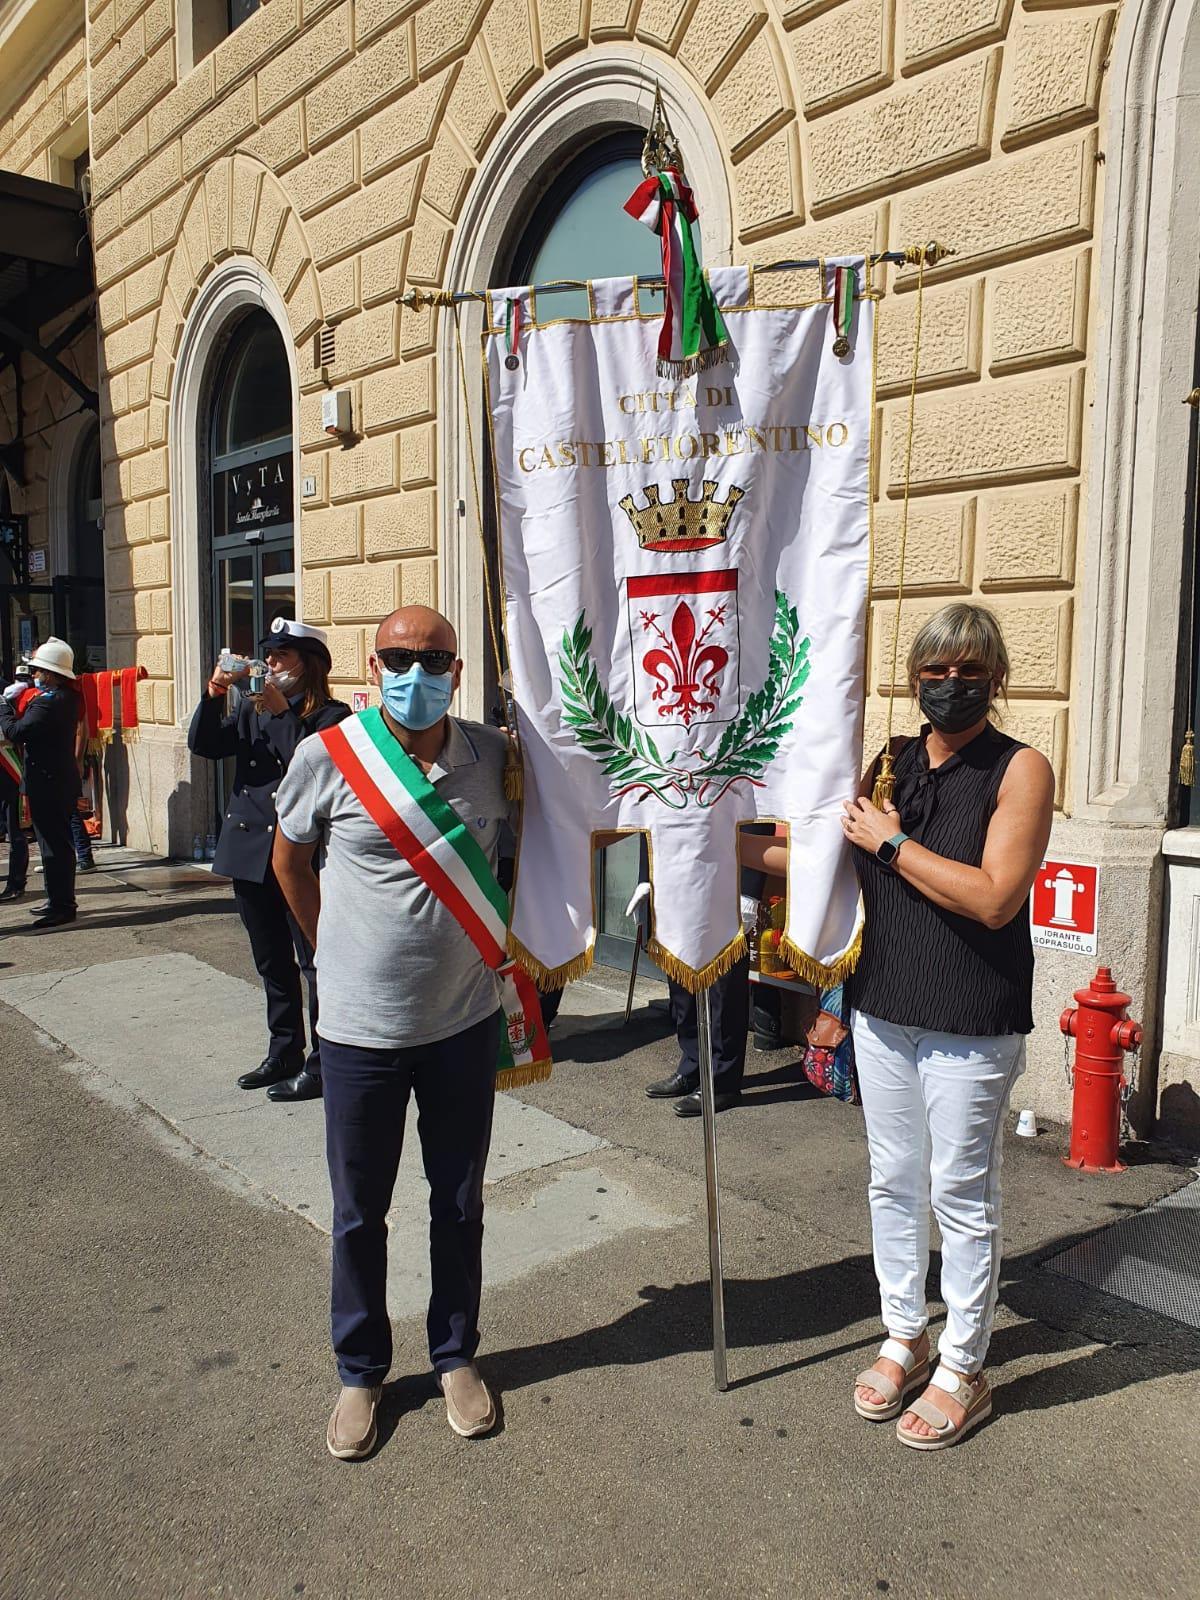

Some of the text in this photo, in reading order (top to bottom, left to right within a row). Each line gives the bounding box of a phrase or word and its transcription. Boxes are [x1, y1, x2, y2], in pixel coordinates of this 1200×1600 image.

[617, 384, 734, 416] CITTÀ DI
[518, 422, 848, 473] CASTELFIORENTINO
[1033, 936, 1093, 953] SOPRASUOLO
[1044, 929, 1081, 942] IDRANTE
